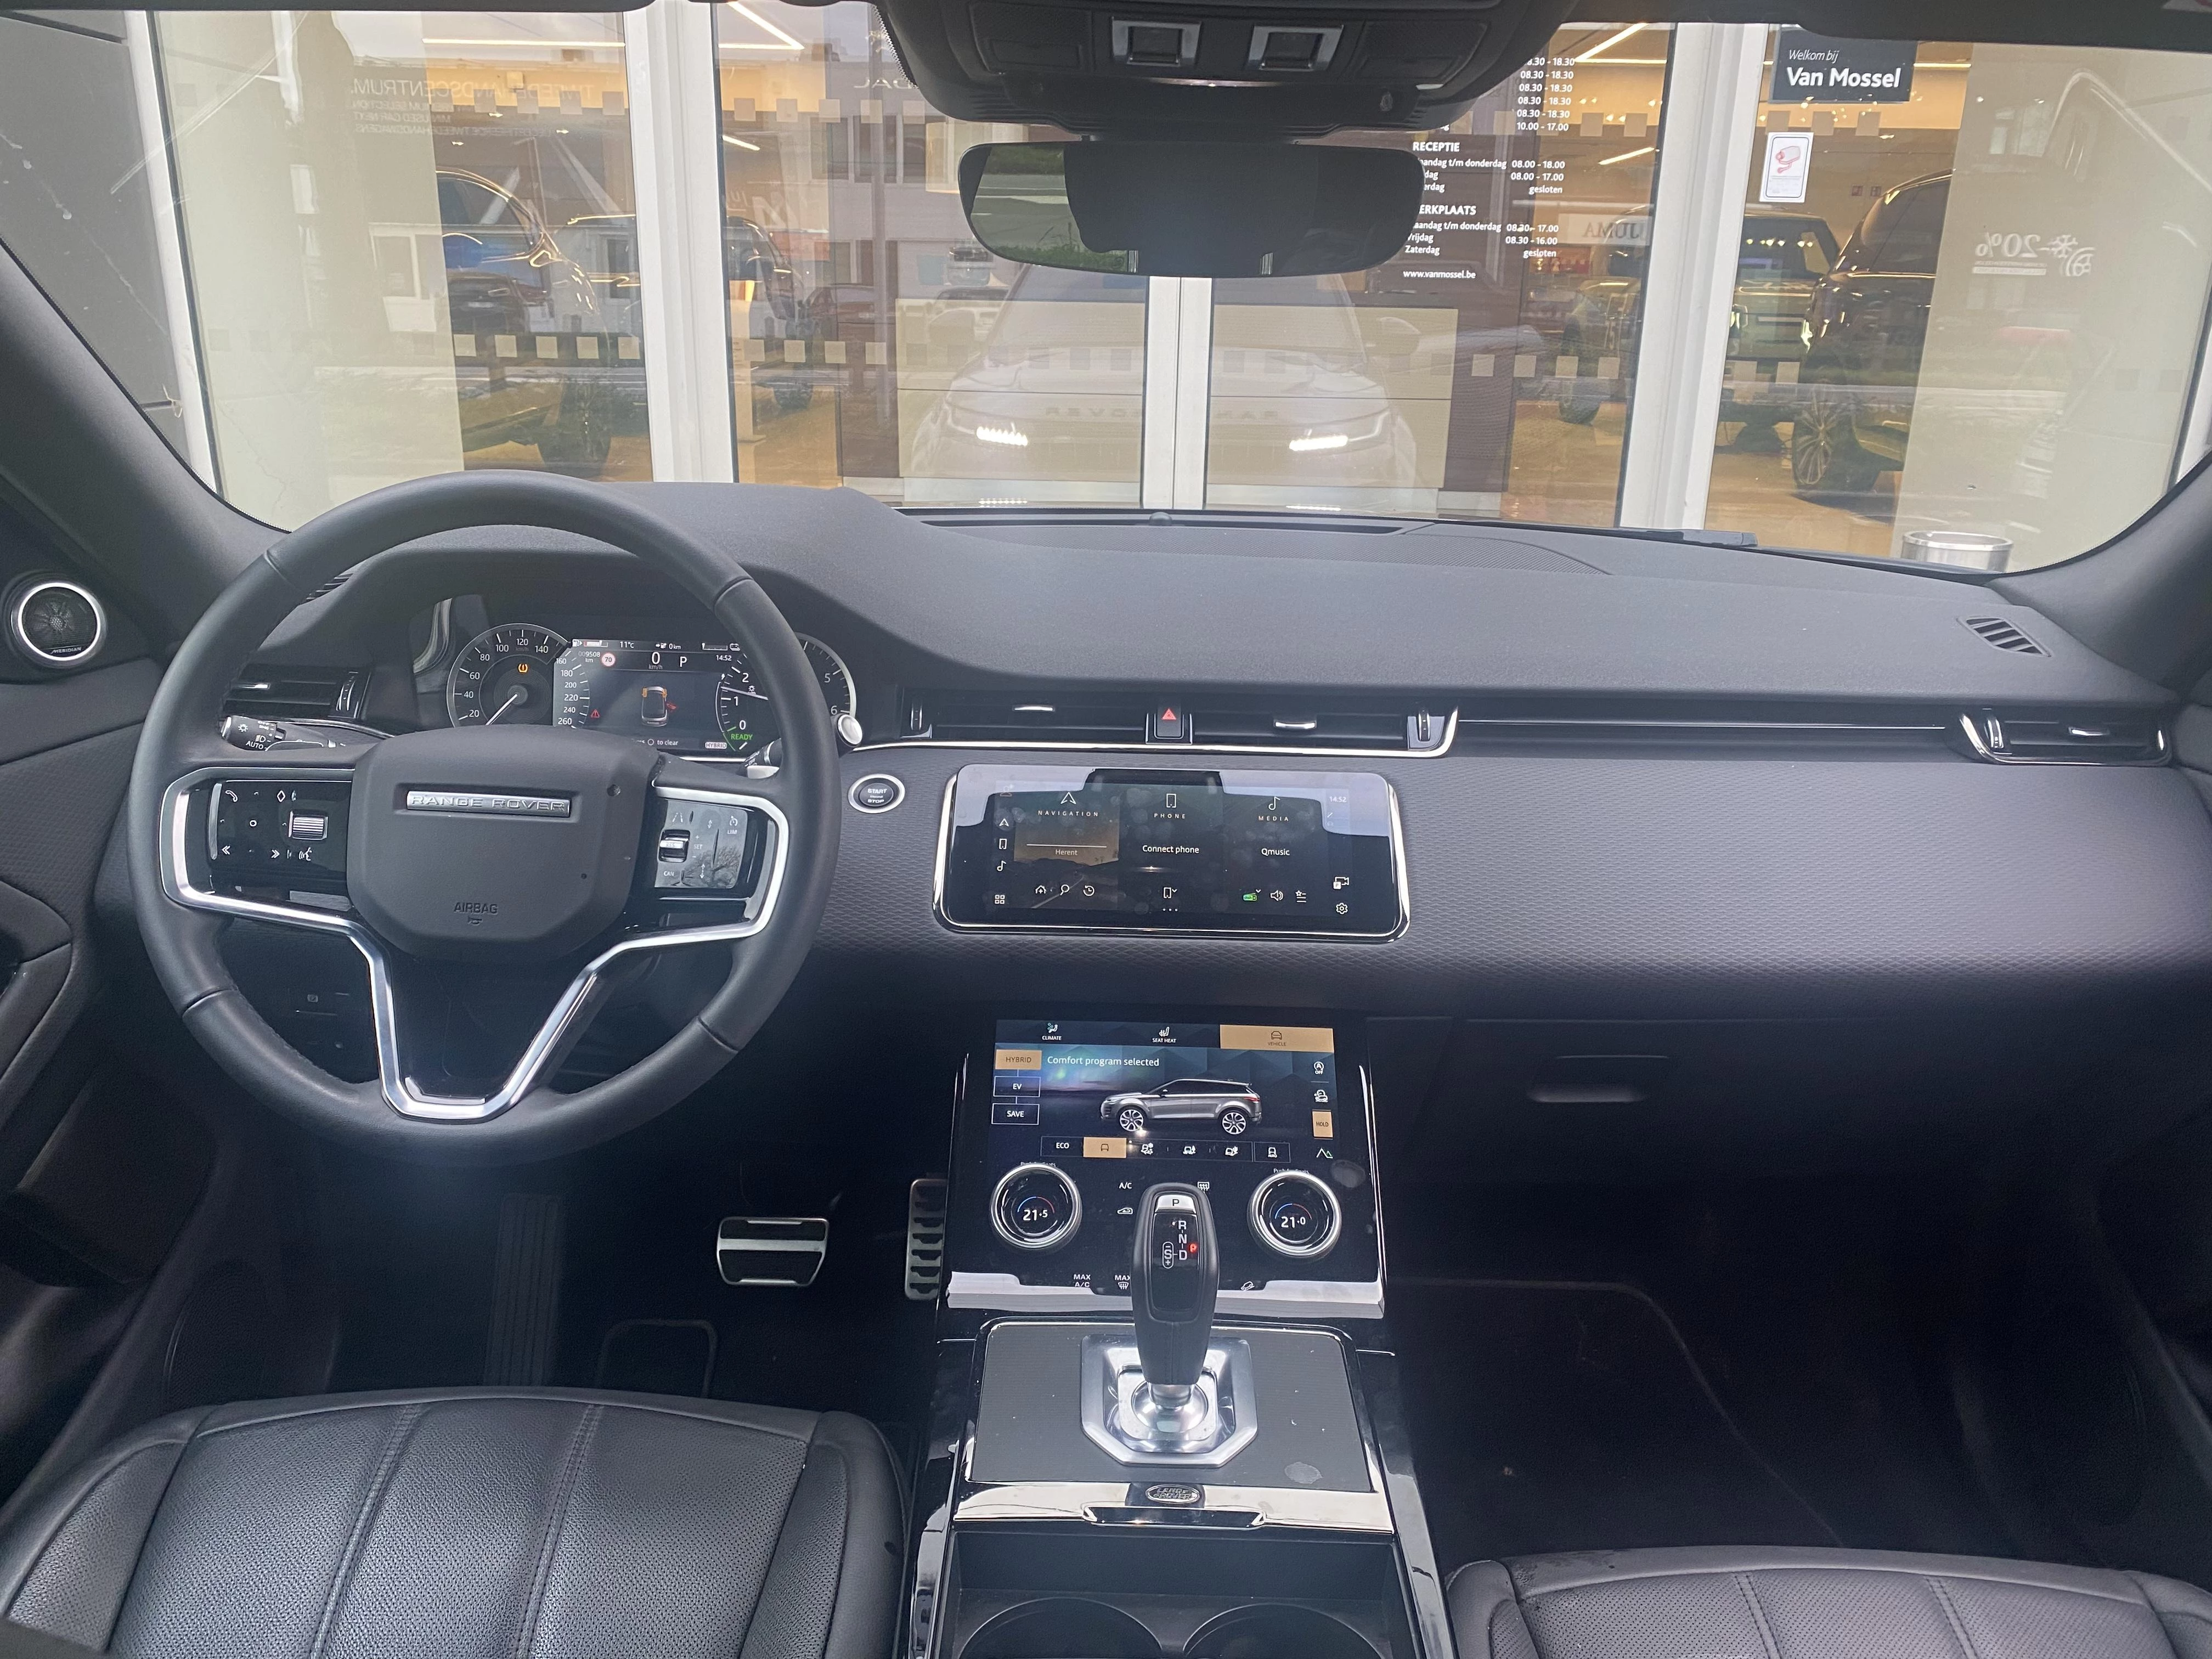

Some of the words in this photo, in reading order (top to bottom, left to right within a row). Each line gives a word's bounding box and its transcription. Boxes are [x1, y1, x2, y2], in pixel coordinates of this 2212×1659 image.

[1788, 49, 1825, 60] Welkom
[1826, 50, 1839, 63] bij
[1553, 57, 1575, 66] 18.30
[1520, 70, 1544, 79] 08.30
[1551, 71, 1574, 79] 18.30
[1786, 67, 1824, 86] Van
[1829, 67, 1901, 88] Mossel
[1519, 83, 1543, 92] 08.30
[1550, 84, 1573, 92] 18.30
[1517, 96, 1542, 105] 08.30
[1548, 97, 1571, 105] 18.30
[1516, 109, 1541, 117] 08.30
[1547, 110, 1570, 118] 18.30
[1516, 122, 1539, 130] 10.00
[1547, 122, 1569, 131] 17.00
[1413, 142, 1460, 152] RECEPTIE
[1465, 159, 1507, 170] donderdag
[1511, 160, 1536, 168] 08.00
[1543, 161, 1565, 169] 18.00
[1511, 172, 1534, 180] 08.00
[1543, 173, 1564, 181] 17.00
[1528, 185, 1563, 194] gesloten
[1419, 205, 1476, 215] ERKPLAATS
[1414, 221, 1442, 231] aandag
[1444, 222, 1458, 230] t/m
[1460, 222, 1502, 232] donderdag
[1506, 224, 1530, 232] 08.30
[1505, 236, 1529, 244] 08.30
[1536, 236, 1558, 245] 16.00
[1404, 245, 1440, 256] Zaterdag
[1523, 249, 1556, 259] gesloten
[1403, 270, 1476, 279] www.vanmossel.be
[651, 652, 660, 664] 0
[680, 656, 687, 667] P
[742, 673, 749, 682] 2
[824, 673, 831, 683] 5
[733, 696, 738, 706] 1
[831, 705, 837, 715] 6
[739, 720, 746, 730] 0
[246, 741, 263, 749] AUTO
[411, 795, 483, 807] RANGE
[492, 798, 566, 811] ROVER
[1142, 844, 1173, 853] Connect
[1175, 845, 1199, 854] phone
[1261, 848, 1290, 856] Qmusic
[453, 902, 498, 915] AIRBAG
[1047, 1056, 1083, 1065] Comfort
[1085, 1057, 1122, 1067] program
[1124, 1058, 1160, 1066] selected
[1178, 1221, 1187, 1229] R
[1179, 1234, 1187, 1244] N
[1164, 1249, 1172, 1259] S
[1179, 1250, 1187, 1260] D
